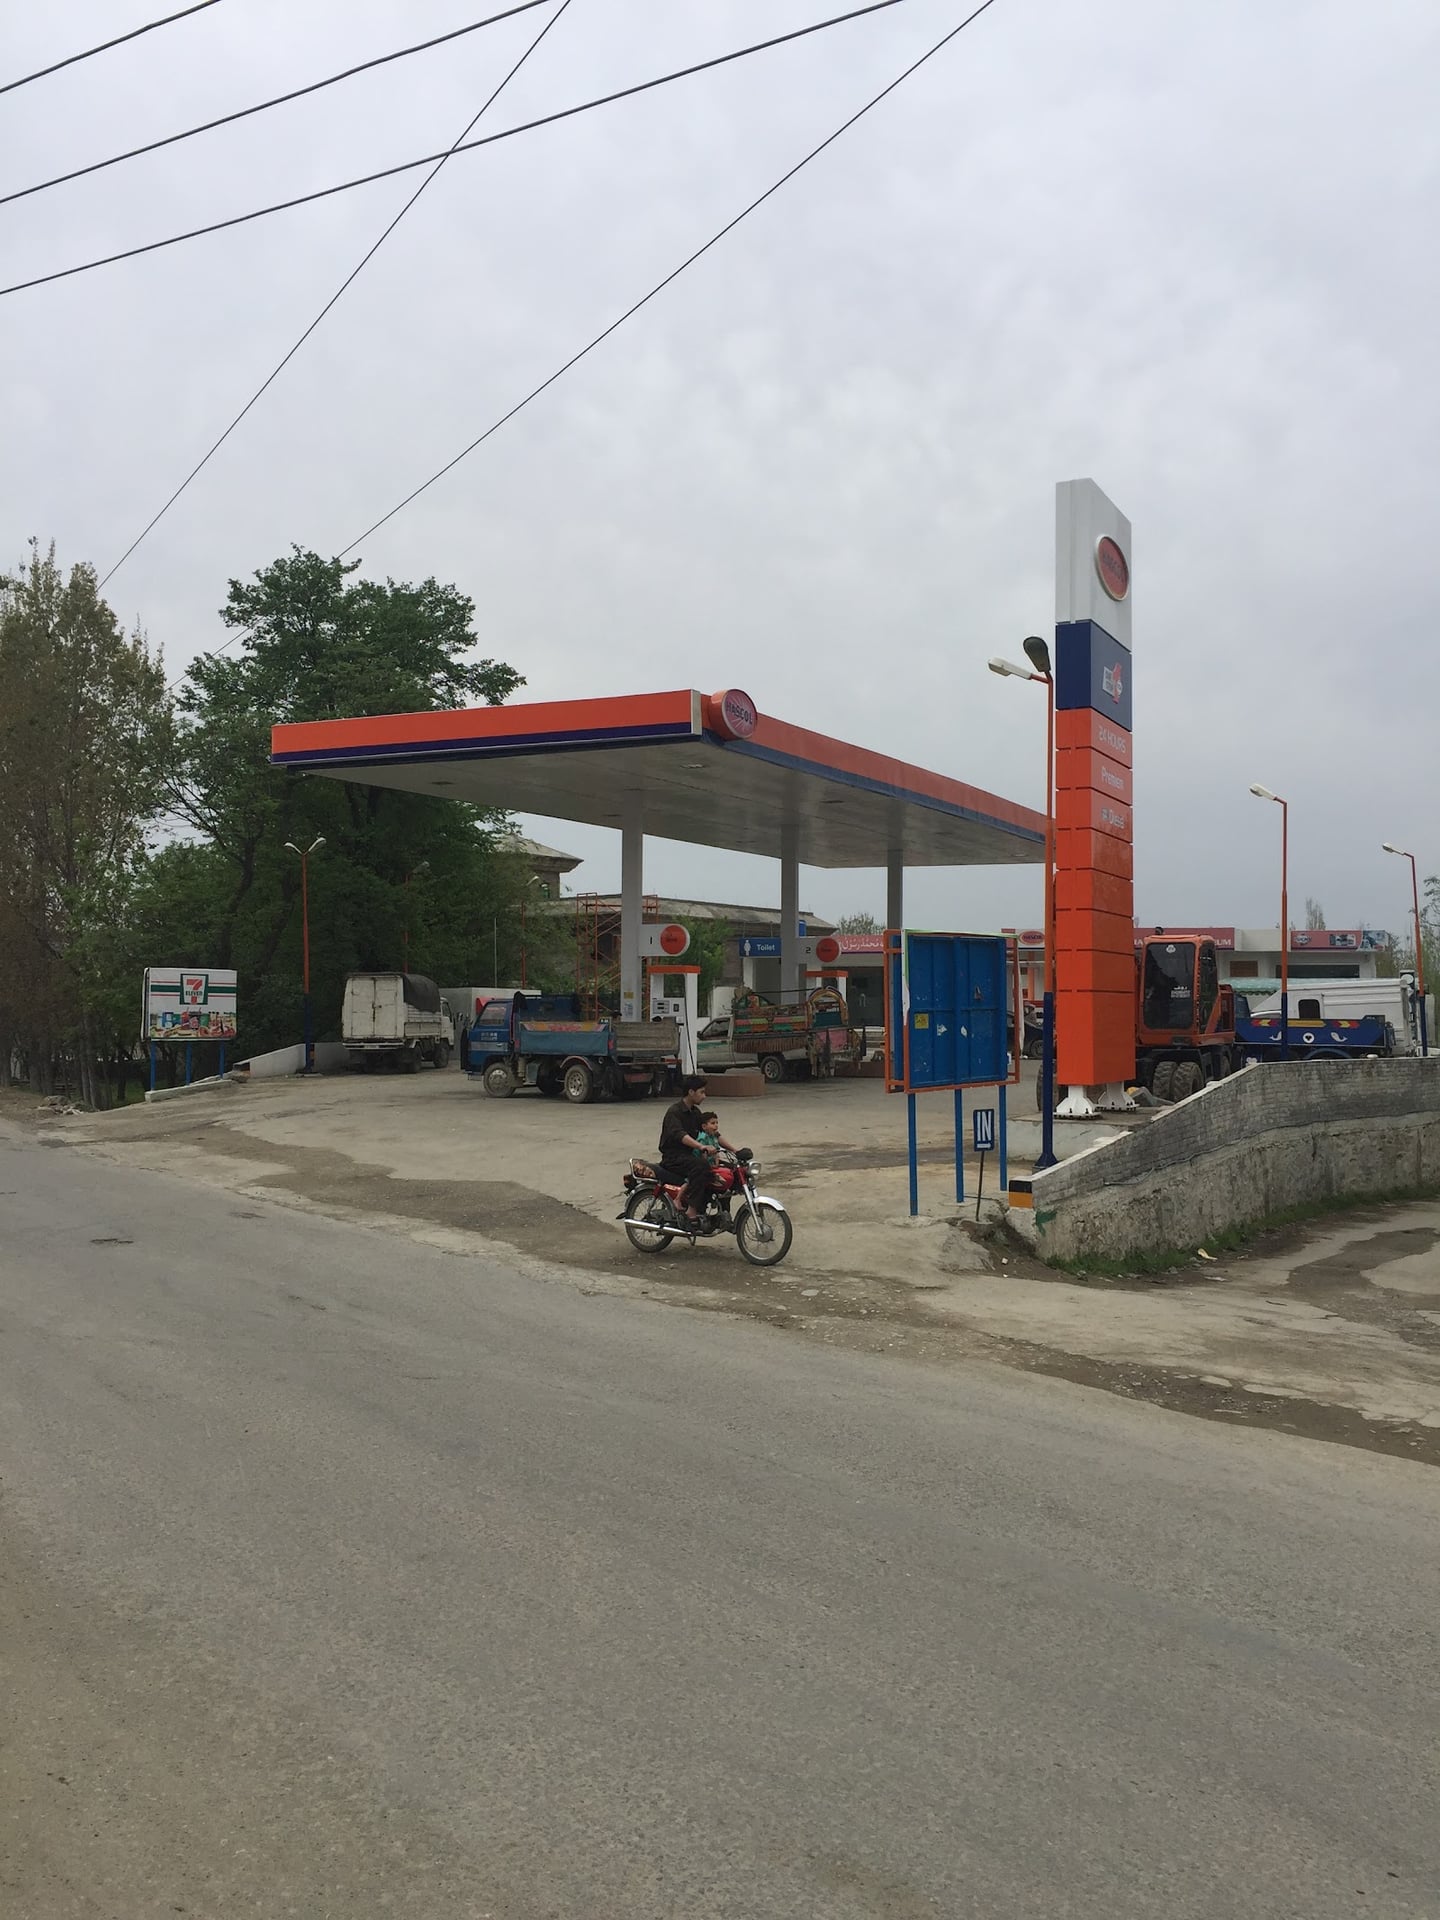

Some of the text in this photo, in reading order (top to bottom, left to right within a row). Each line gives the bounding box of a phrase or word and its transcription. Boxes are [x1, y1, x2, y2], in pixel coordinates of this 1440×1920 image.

[1107, 730, 1126, 753] HOURS
[756, 943, 776, 951] Toilet
[186, 978, 203, 1003] 7
[976, 1111, 992, 1141] IN
